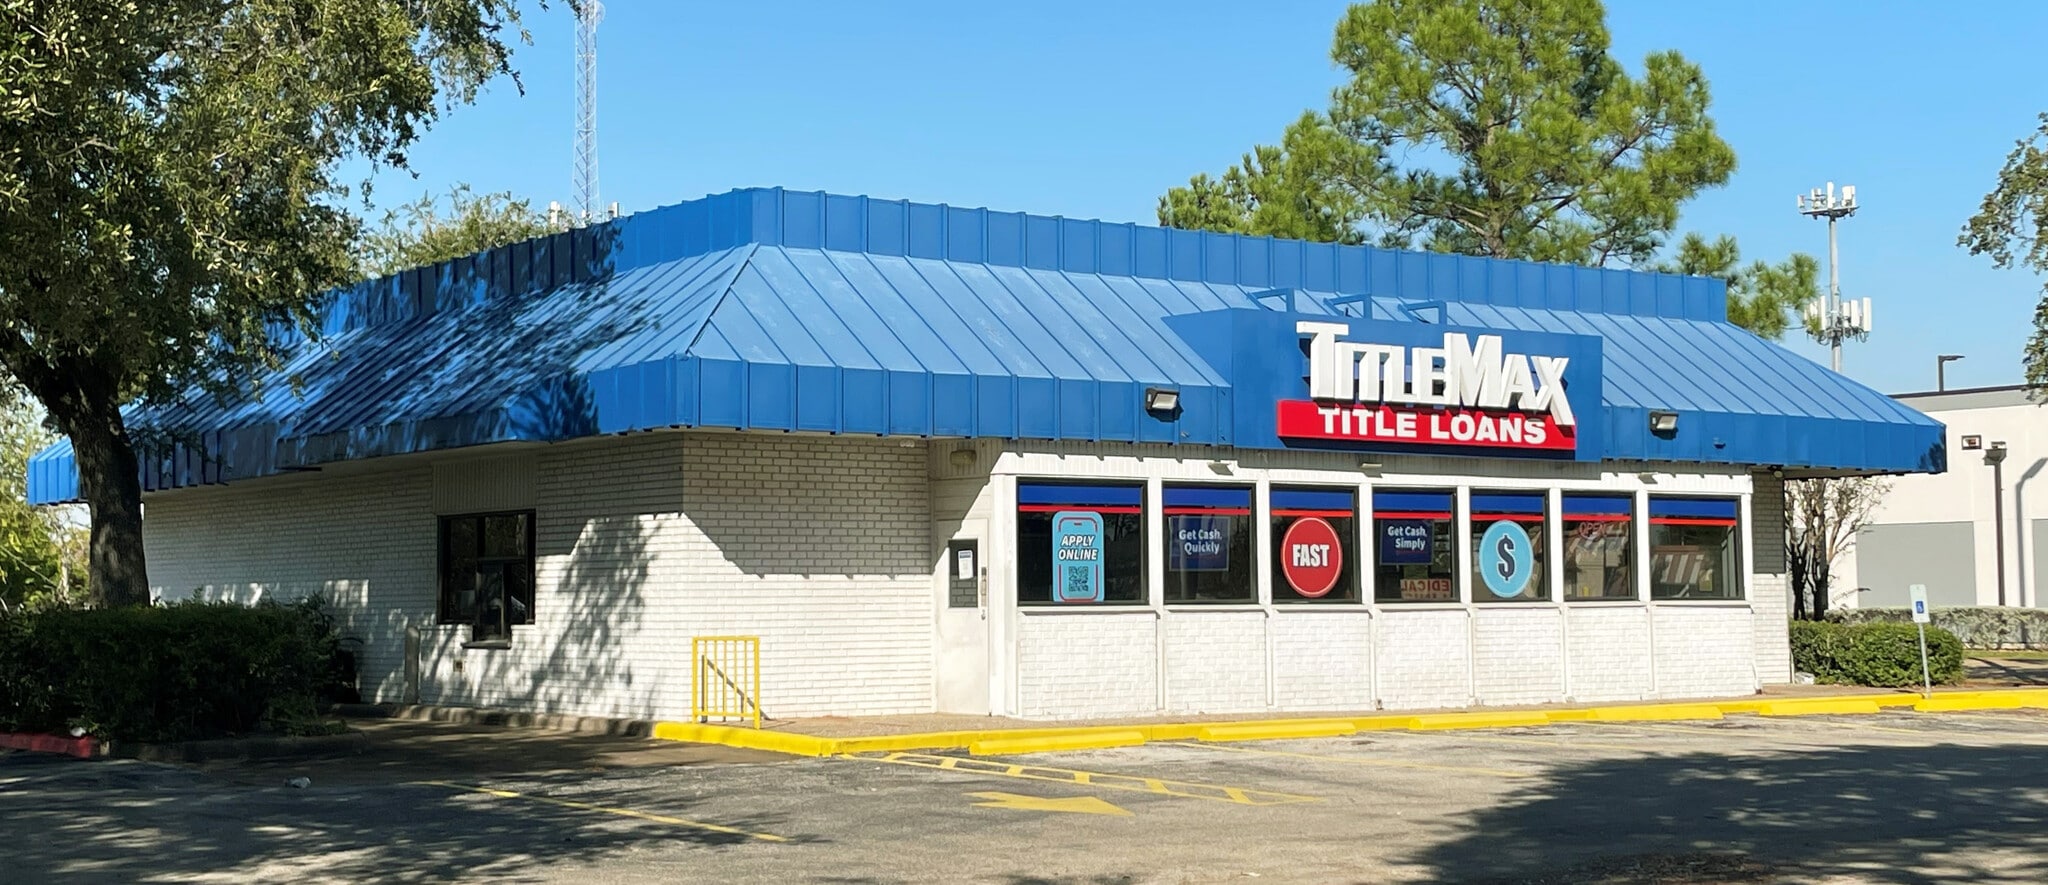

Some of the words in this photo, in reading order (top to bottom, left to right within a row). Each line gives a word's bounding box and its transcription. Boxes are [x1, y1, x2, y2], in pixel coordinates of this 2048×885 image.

[1317, 406, 1417, 438] TITLE
[1430, 413, 1547, 445] LOANS
[1178, 529, 1197, 540] Get
[1387, 525, 1404, 536] Get
[1061, 535, 1095, 546] APPLY
[1394, 537, 1426, 551] Simply
[1058, 549, 1098, 561] ONLINE
[1184, 541, 1220, 555] Quickly
[1292, 544, 1330, 567] FAST
[1497, 534, 1515, 582] $
